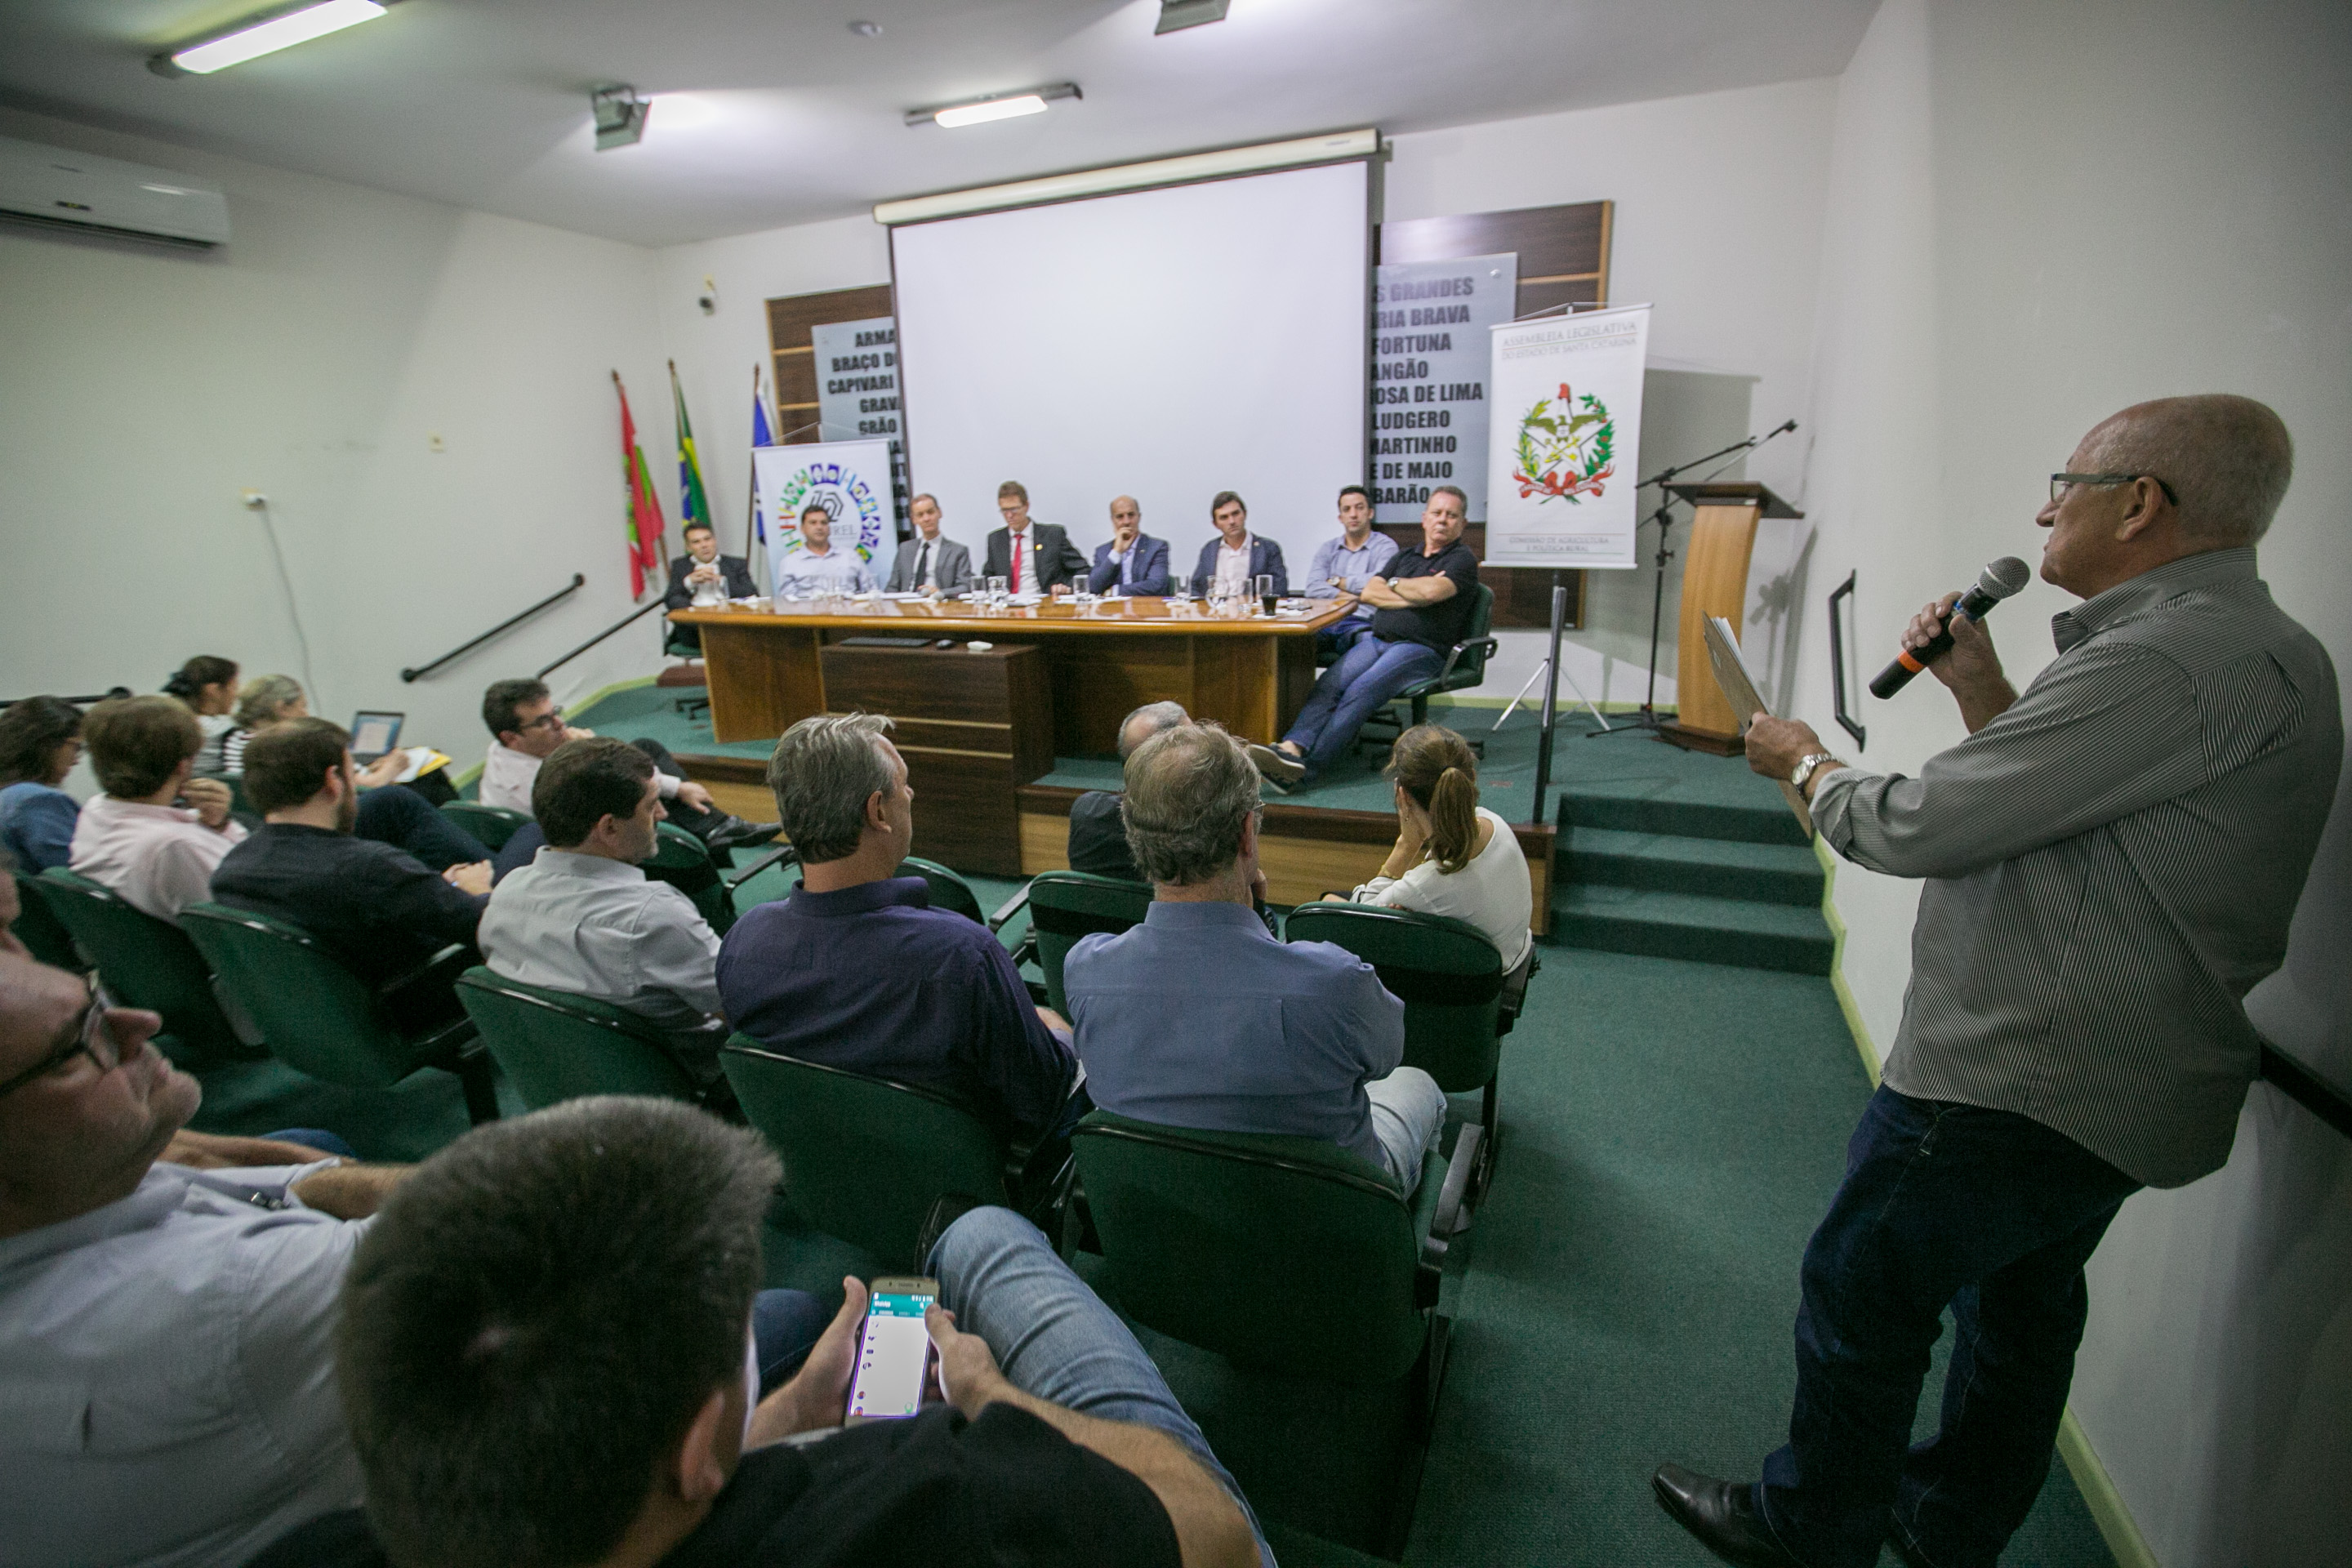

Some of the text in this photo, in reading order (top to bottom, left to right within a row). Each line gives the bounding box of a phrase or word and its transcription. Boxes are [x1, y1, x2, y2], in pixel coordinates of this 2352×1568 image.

[1390, 276, 1473, 301] GRANDES
[1410, 305, 1470, 326] BRAVA
[1372, 332, 1451, 355] FORTUNA
[831, 353, 880, 372] BRAÇO
[827, 374, 894, 394] CAPIVARI
[1414, 385, 1435, 403] DE
[1441, 382, 1483, 402] LIMA
[860, 396, 901, 413] GRAV
[858, 416, 897, 435] GRÃO
[1372, 410, 1450, 430] LUDGERO
[1383, 462, 1403, 479] DE
[1408, 461, 1453, 479] MAIO
[1374, 483, 1429, 504] BARÃO
[831, 524, 858, 536] REL
